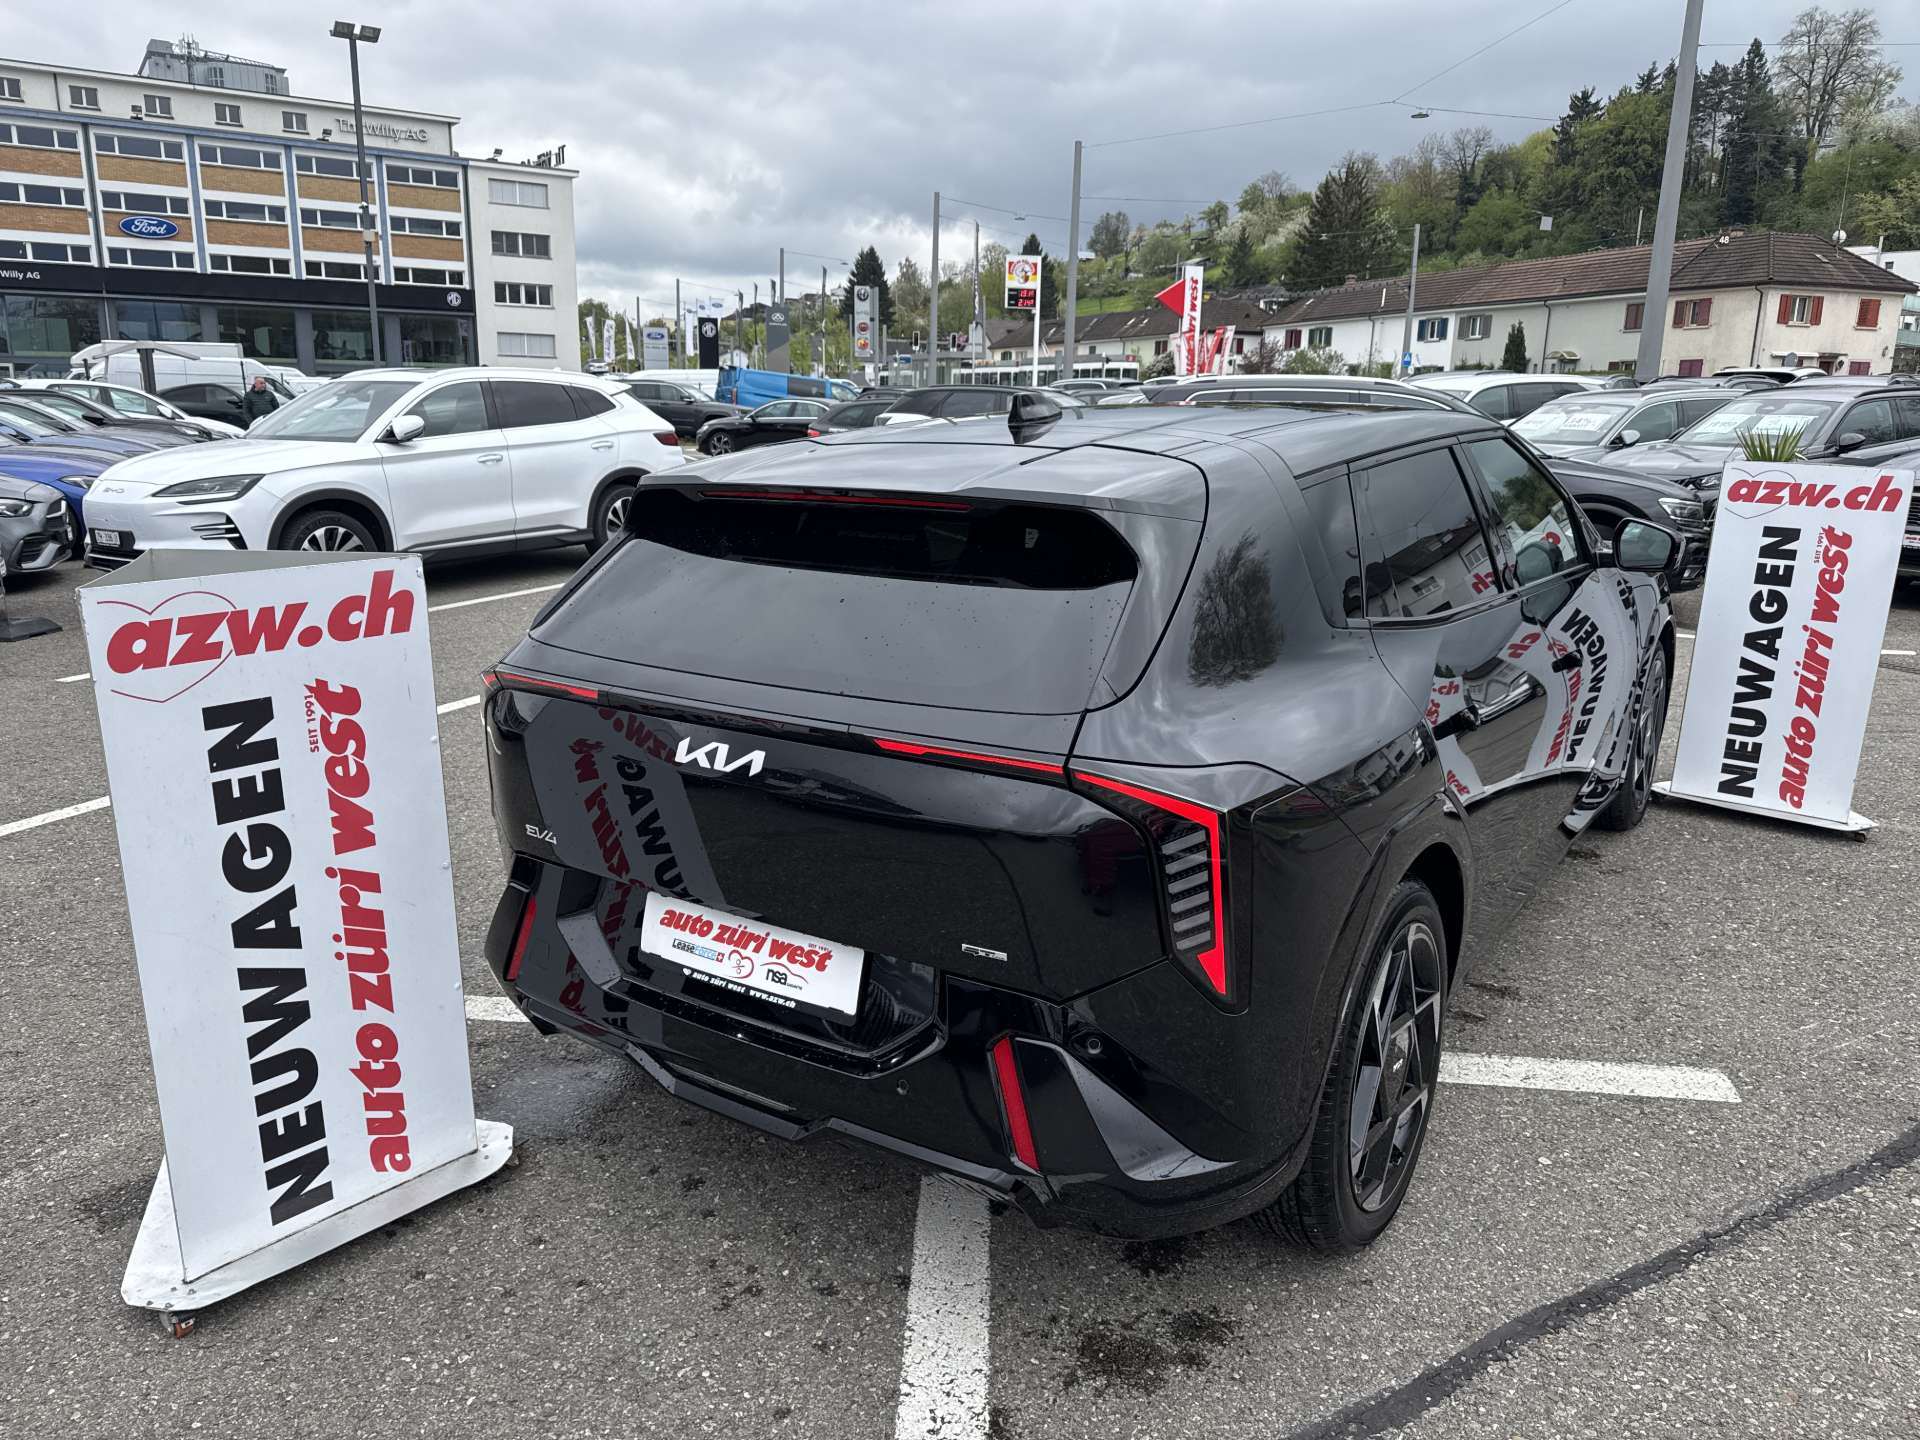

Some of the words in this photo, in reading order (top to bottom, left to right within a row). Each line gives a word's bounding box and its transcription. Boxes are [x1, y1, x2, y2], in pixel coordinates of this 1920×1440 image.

[364, 120, 401, 142] Willy
[405, 127, 430, 143] AG
[131, 217, 167, 235] Ford
[0, 269, 24, 280] Willy
[26, 270, 41, 280] AG
[446, 291, 462, 307] MG
[701, 321, 717, 338] MG
[1727, 475, 1904, 512] azw.ch
[1810, 525, 1853, 624] west
[106, 569, 415, 675] azw.ch
[1717, 526, 1802, 799] NEUWAGEN
[1793, 624, 1835, 719] züri
[303, 694, 316, 723] 1991
[308, 728, 320, 753] SEIT
[675, 736, 766, 778] KIA
[303, 677, 377, 856] west
[1778, 716, 1816, 810] auto
[525, 824, 557, 845] EV4
[324, 866, 395, 1014] züri
[659, 908, 714, 938] auto
[711, 923, 771, 954] züri
[768, 937, 833, 972] west
[201, 696, 334, 1227] NEUWAGEN
[765, 968, 788, 986] nsa
[692, 971, 709, 983] auto
[727, 983, 746, 993] west
[749, 989, 796, 1009] www.azw.ch
[349, 1022, 412, 1173] auto
